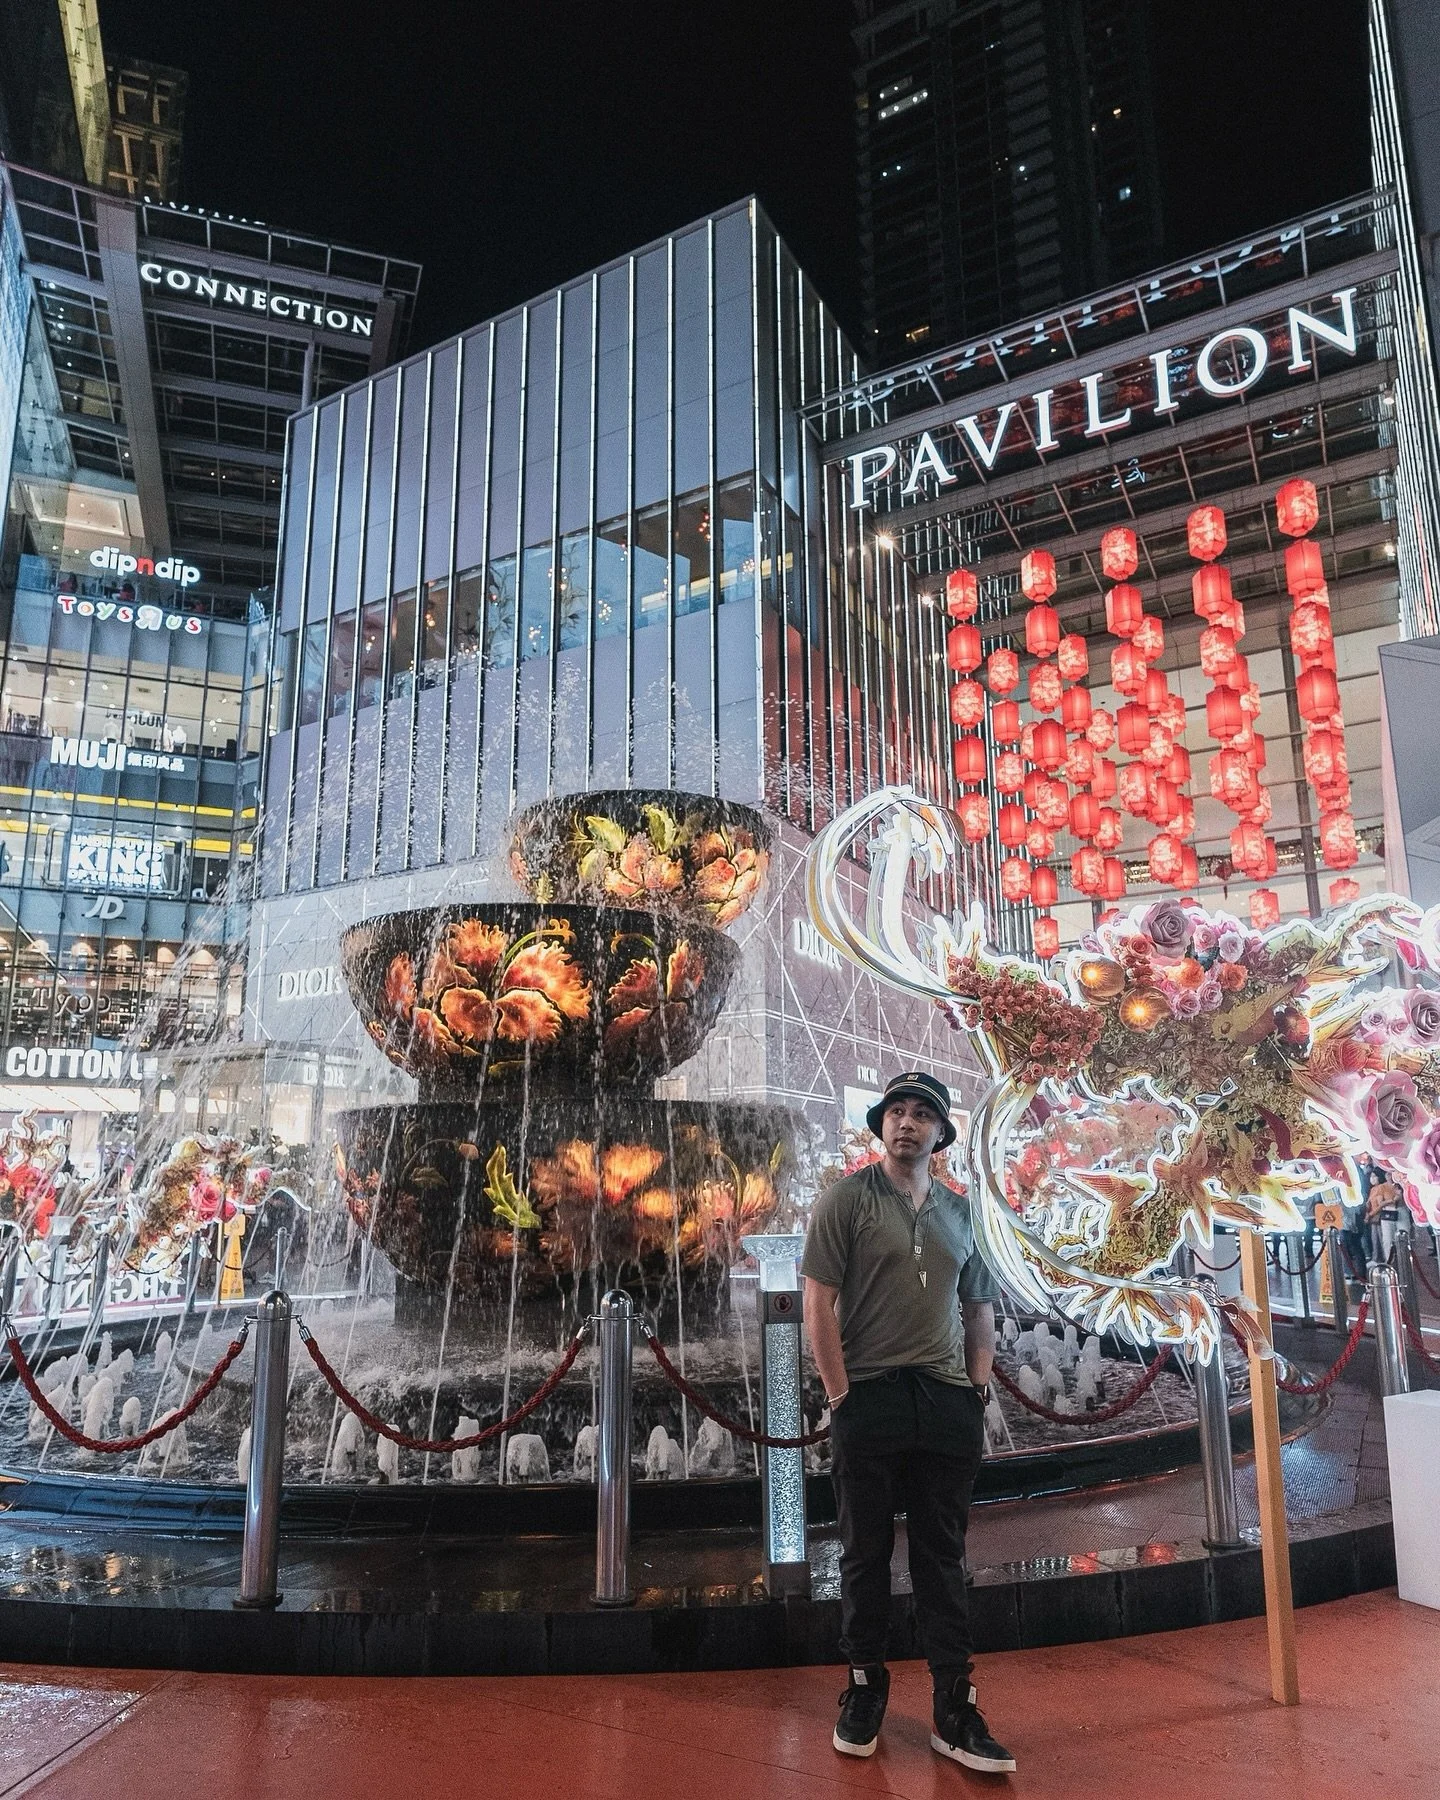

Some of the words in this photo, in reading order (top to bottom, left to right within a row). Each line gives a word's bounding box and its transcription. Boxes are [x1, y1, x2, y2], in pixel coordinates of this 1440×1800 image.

[140, 262, 373, 337] CONNECTION
[849, 287, 1358, 511] PAVILION
[89, 546, 201, 586] dipndip
[50, 736, 127, 771] MUJI
[68, 846, 163, 877] KING
[84, 895, 125, 920] JD
[5, 1046, 123, 1081] COTTON
